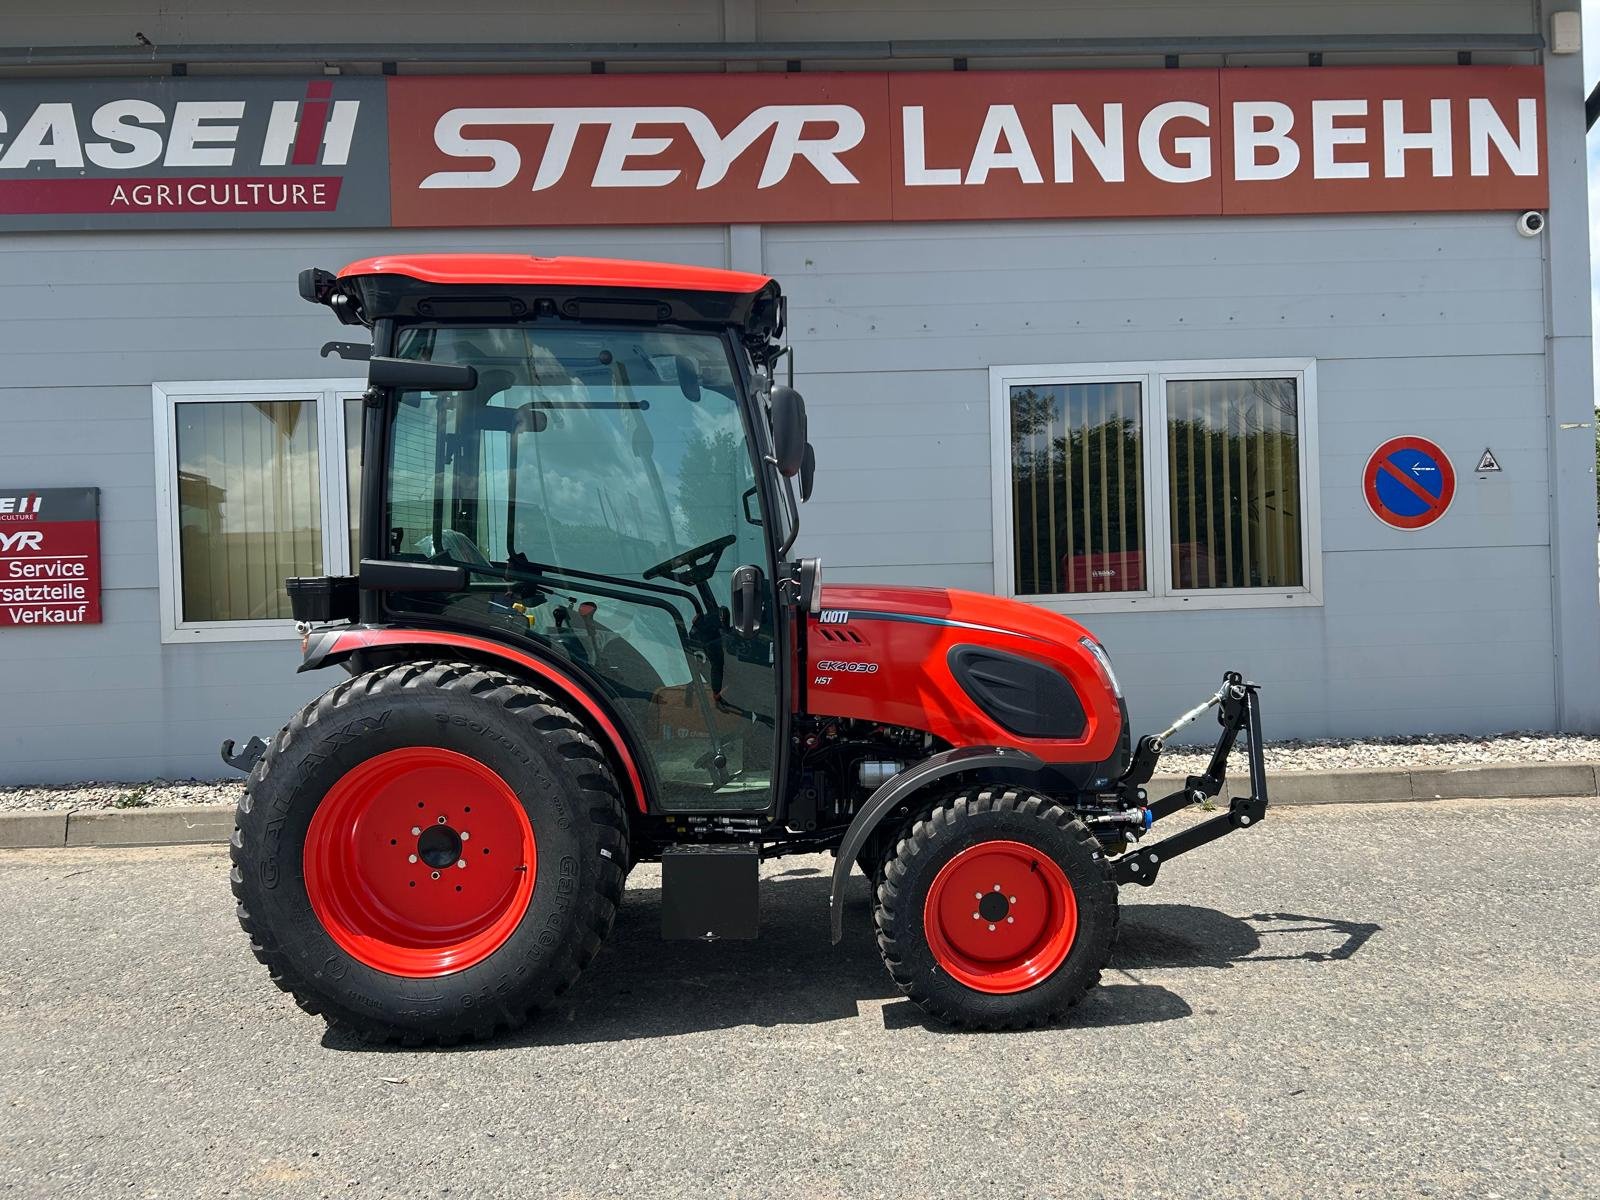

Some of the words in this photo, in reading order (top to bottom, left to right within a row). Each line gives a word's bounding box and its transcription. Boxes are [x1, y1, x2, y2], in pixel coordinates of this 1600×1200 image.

[0, 100, 246, 169] ASE
[902, 98, 1538, 186] LANGBEHN
[418, 104, 866, 191] STEYR
[110, 184, 326, 206] AGRICULTURE
[0, 531, 43, 551] YR
[9, 560, 85, 578] Service
[8, 605, 86, 623] Verkauf
[820, 610, 848, 624] KIOTI
[816, 660, 878, 674] CK4030
[814, 676, 832, 685] HST
[259, 710, 392, 889] GALAXY
